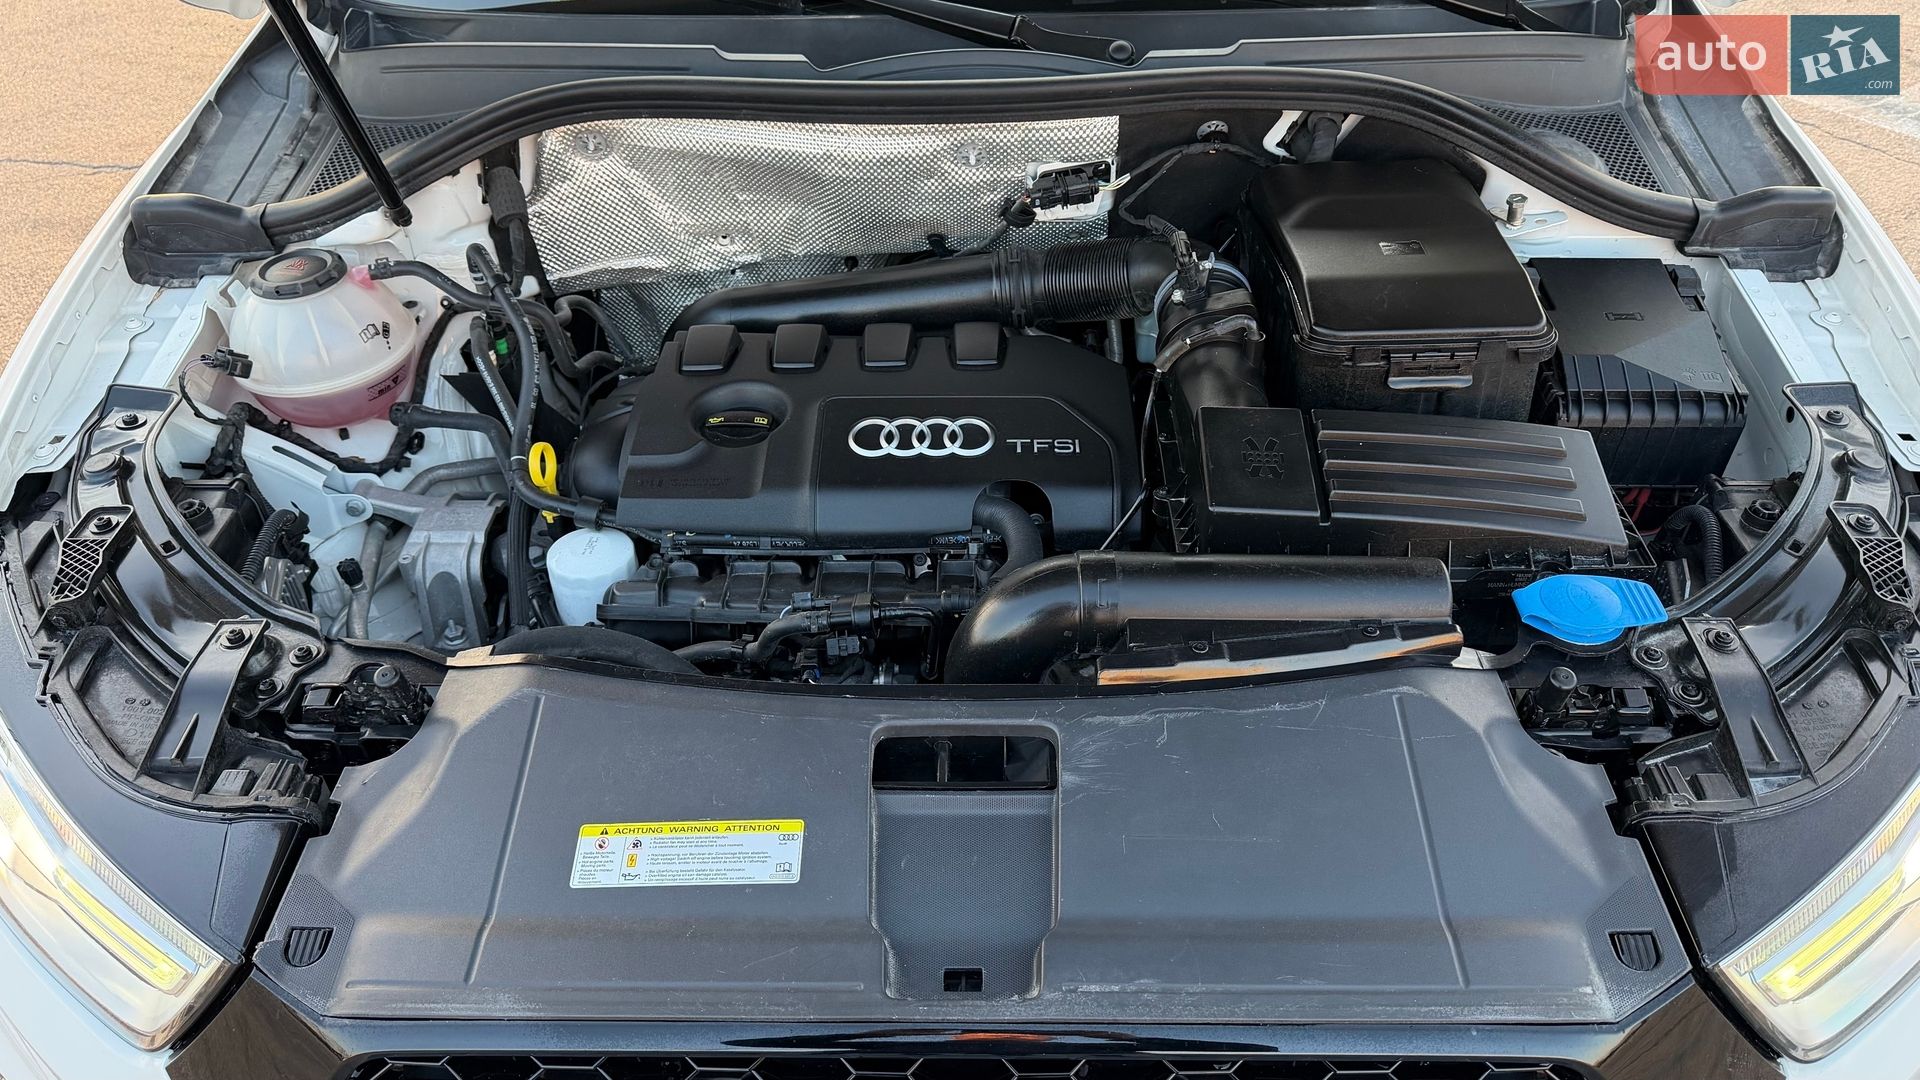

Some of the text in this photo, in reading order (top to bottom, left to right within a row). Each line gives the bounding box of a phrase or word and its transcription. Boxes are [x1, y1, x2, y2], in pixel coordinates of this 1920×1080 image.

[1006, 439, 1080, 453] TFSI
[614, 824, 780, 835] ACHTUNG WARNING ATTENTION
